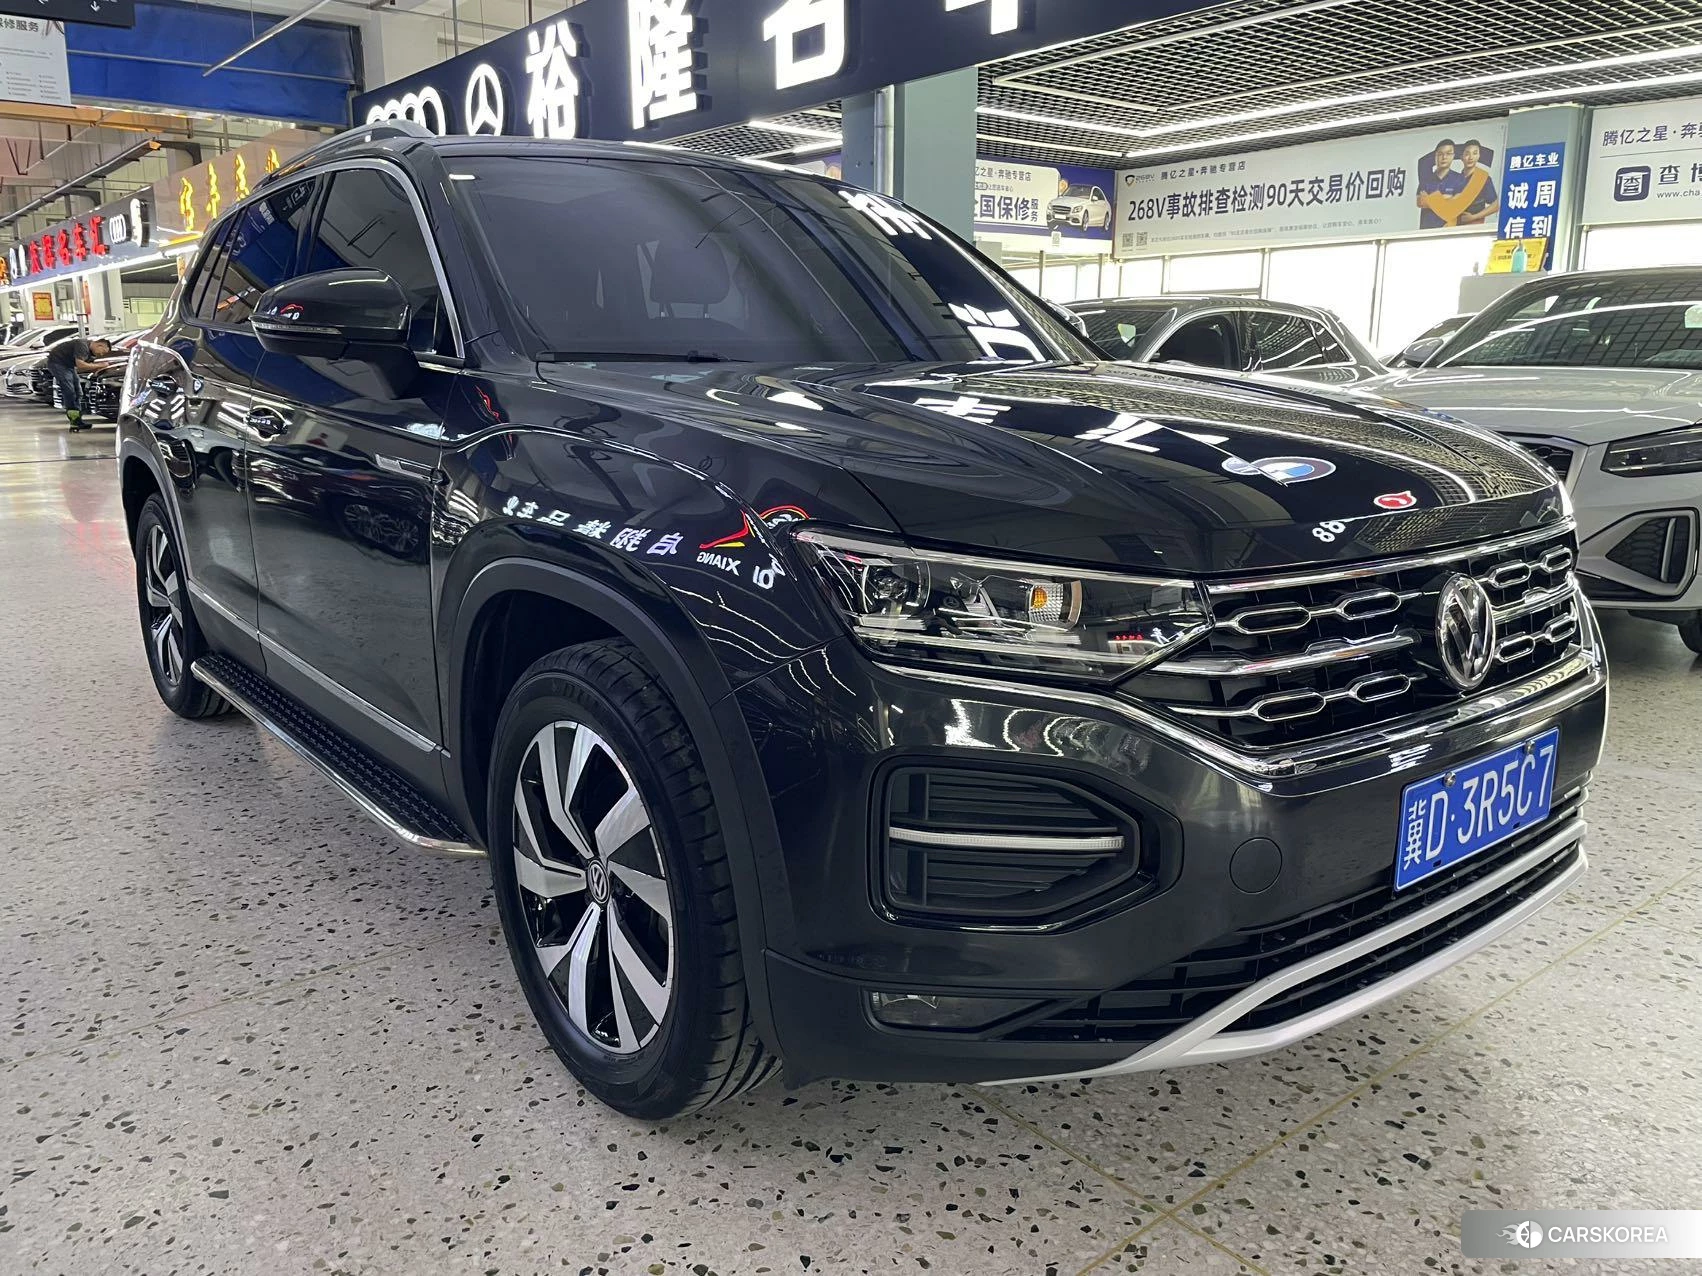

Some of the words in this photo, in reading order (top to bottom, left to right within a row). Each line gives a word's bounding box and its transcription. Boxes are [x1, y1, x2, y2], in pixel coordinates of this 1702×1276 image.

[1602, 122, 1702, 147] 腾亿之星·奔
[1510, 152, 1559, 168] 腾亿车业
[973, 194, 1030, 221] 国保修
[1128, 167, 1406, 221] 268V事故排查检测90天交易价回购
[1404, 744, 1554, 871] 冀D·3R5C7
